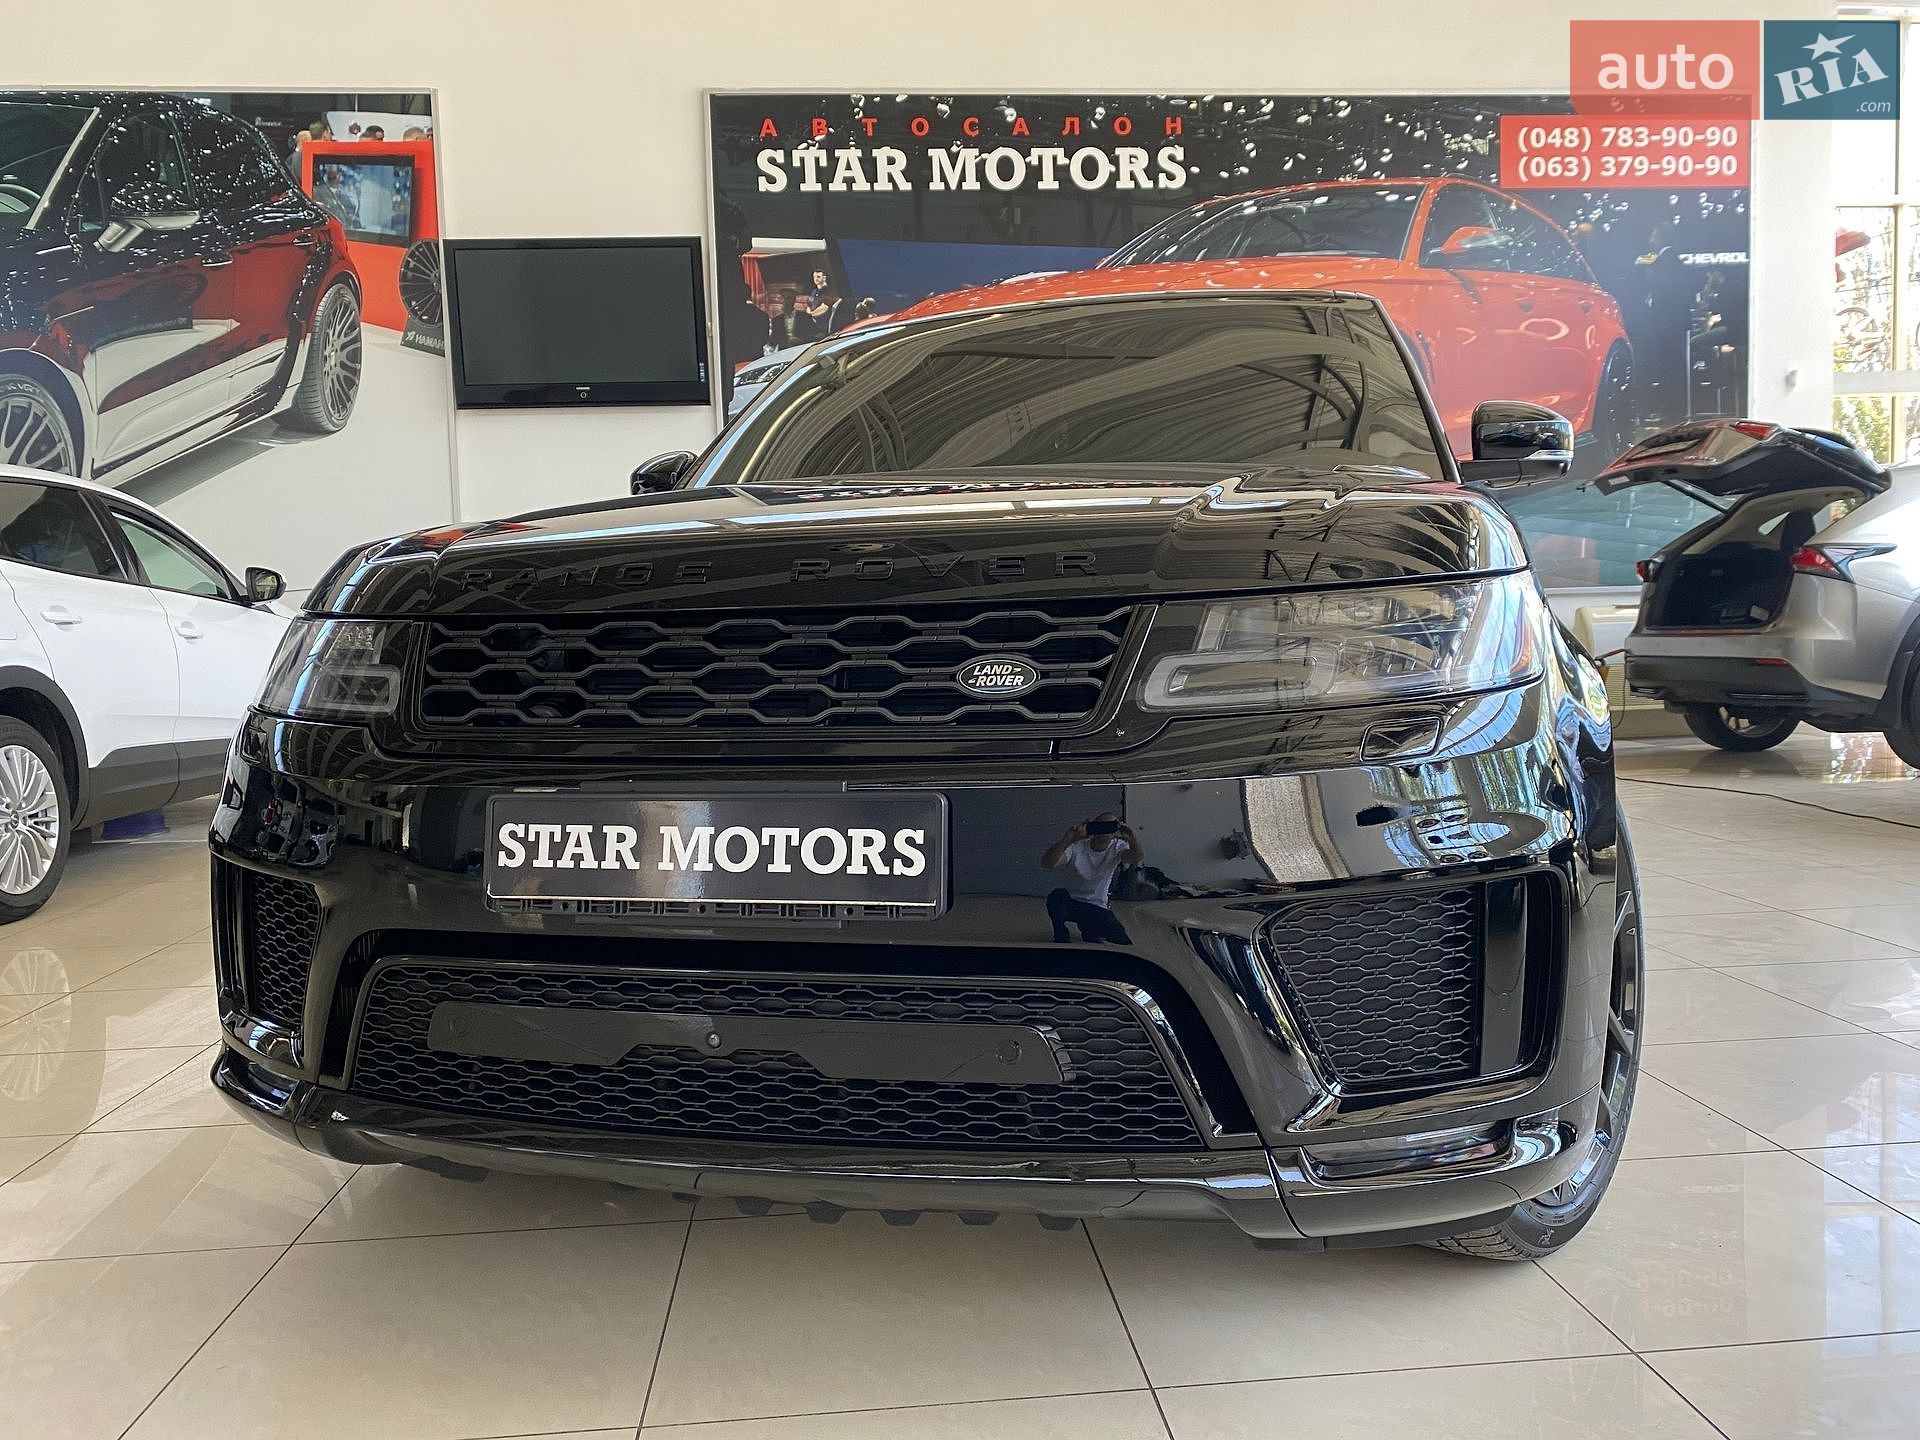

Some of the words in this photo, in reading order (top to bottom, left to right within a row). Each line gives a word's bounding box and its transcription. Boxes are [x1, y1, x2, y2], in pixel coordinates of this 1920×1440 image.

[759, 116, 1182, 138] АВТОСАЛОН
[1518, 126, 1592, 153] (048)
[1600, 126, 1738, 148] 783-90-90
[756, 146, 912, 192] STAR
[928, 146, 1187, 191] MOTORS
[1518, 155, 1592, 182] (063)
[1600, 155, 1738, 177] 379-90-90
[456, 561, 713, 590] RANGE
[790, 551, 1098, 582] ROVER
[973, 664, 1013, 676] LAND
[976, 675, 1024, 687] ROVER
[497, 822, 640, 870] STAR
[657, 825, 926, 877] MOTORS
